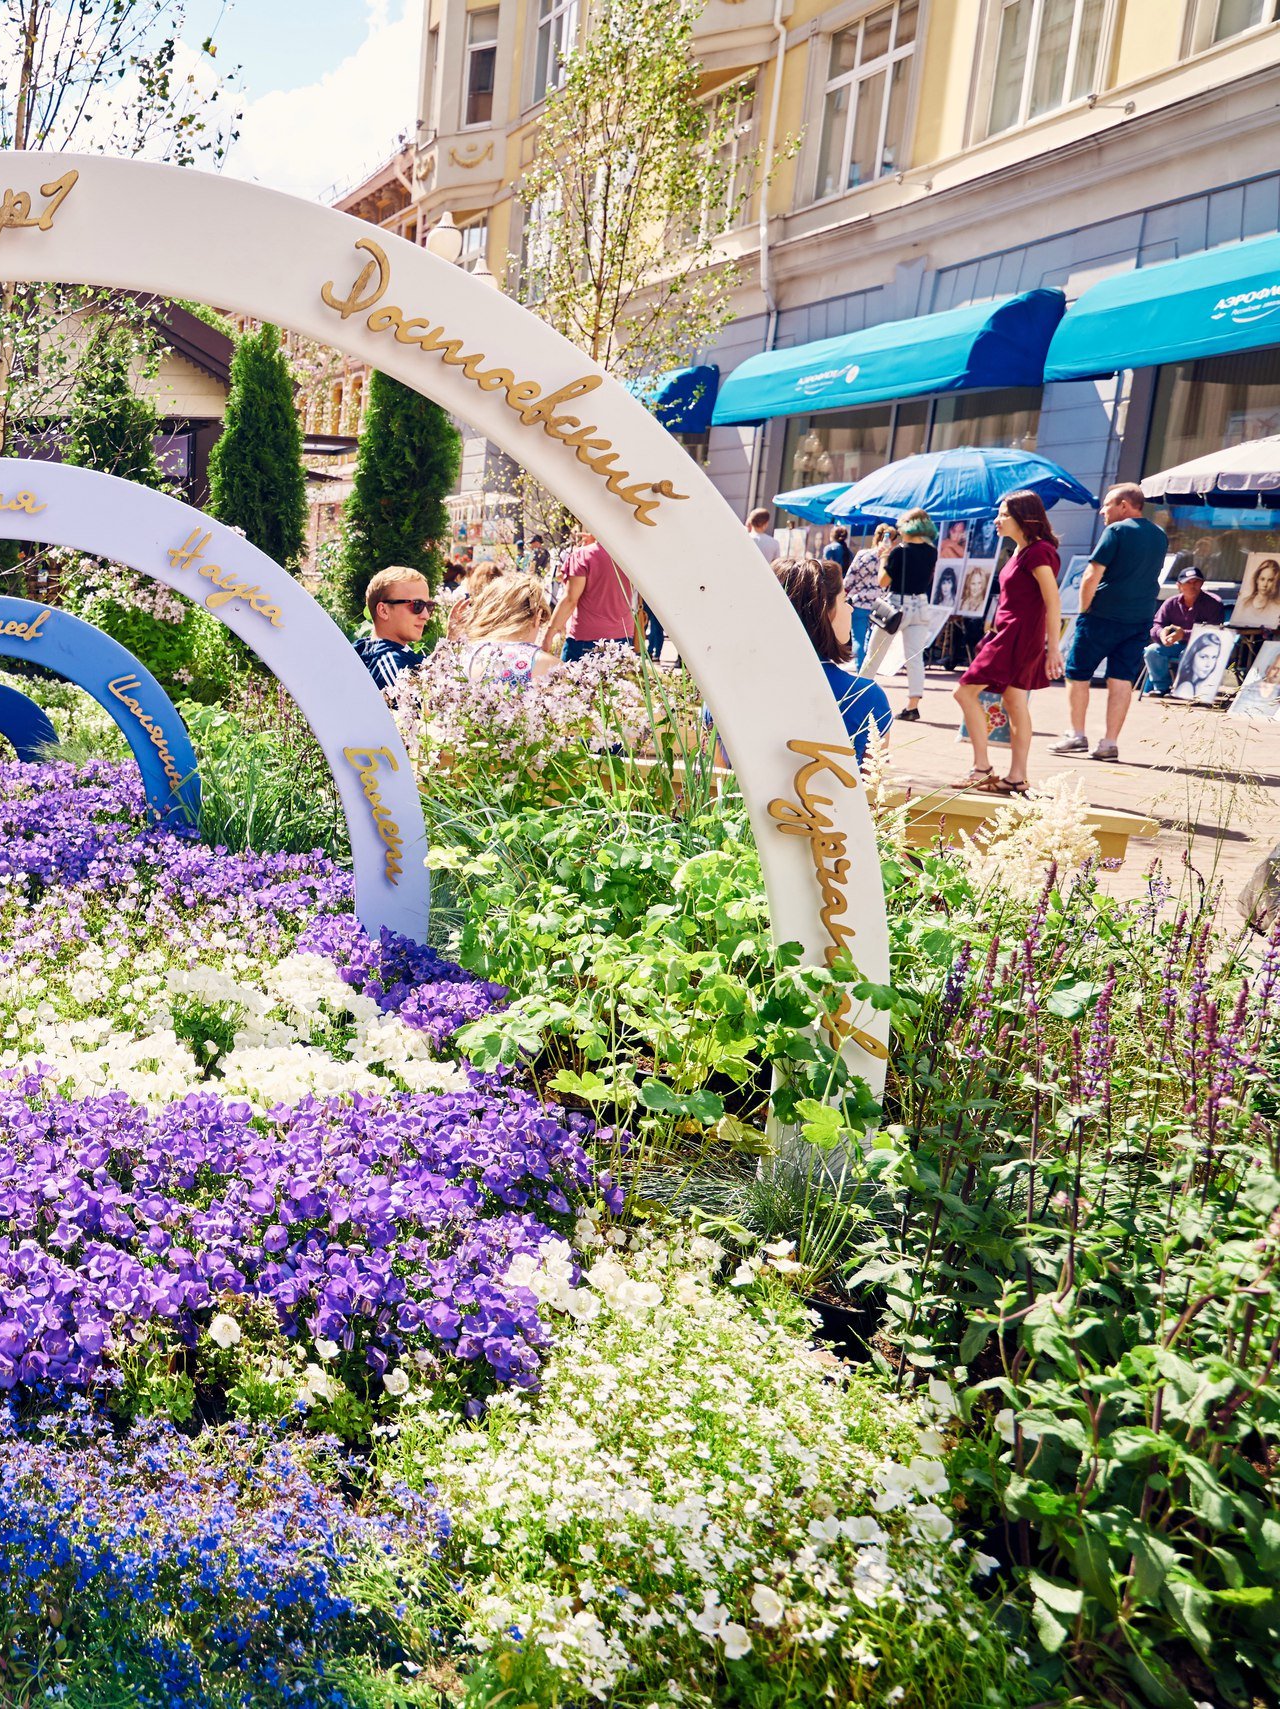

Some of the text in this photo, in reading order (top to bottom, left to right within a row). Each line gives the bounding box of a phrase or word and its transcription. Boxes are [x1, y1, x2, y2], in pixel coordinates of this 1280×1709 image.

[320, 237, 690, 527] Достоевский
[167, 526, 286, 628] Наука
[343, 746, 404, 887] Балет
